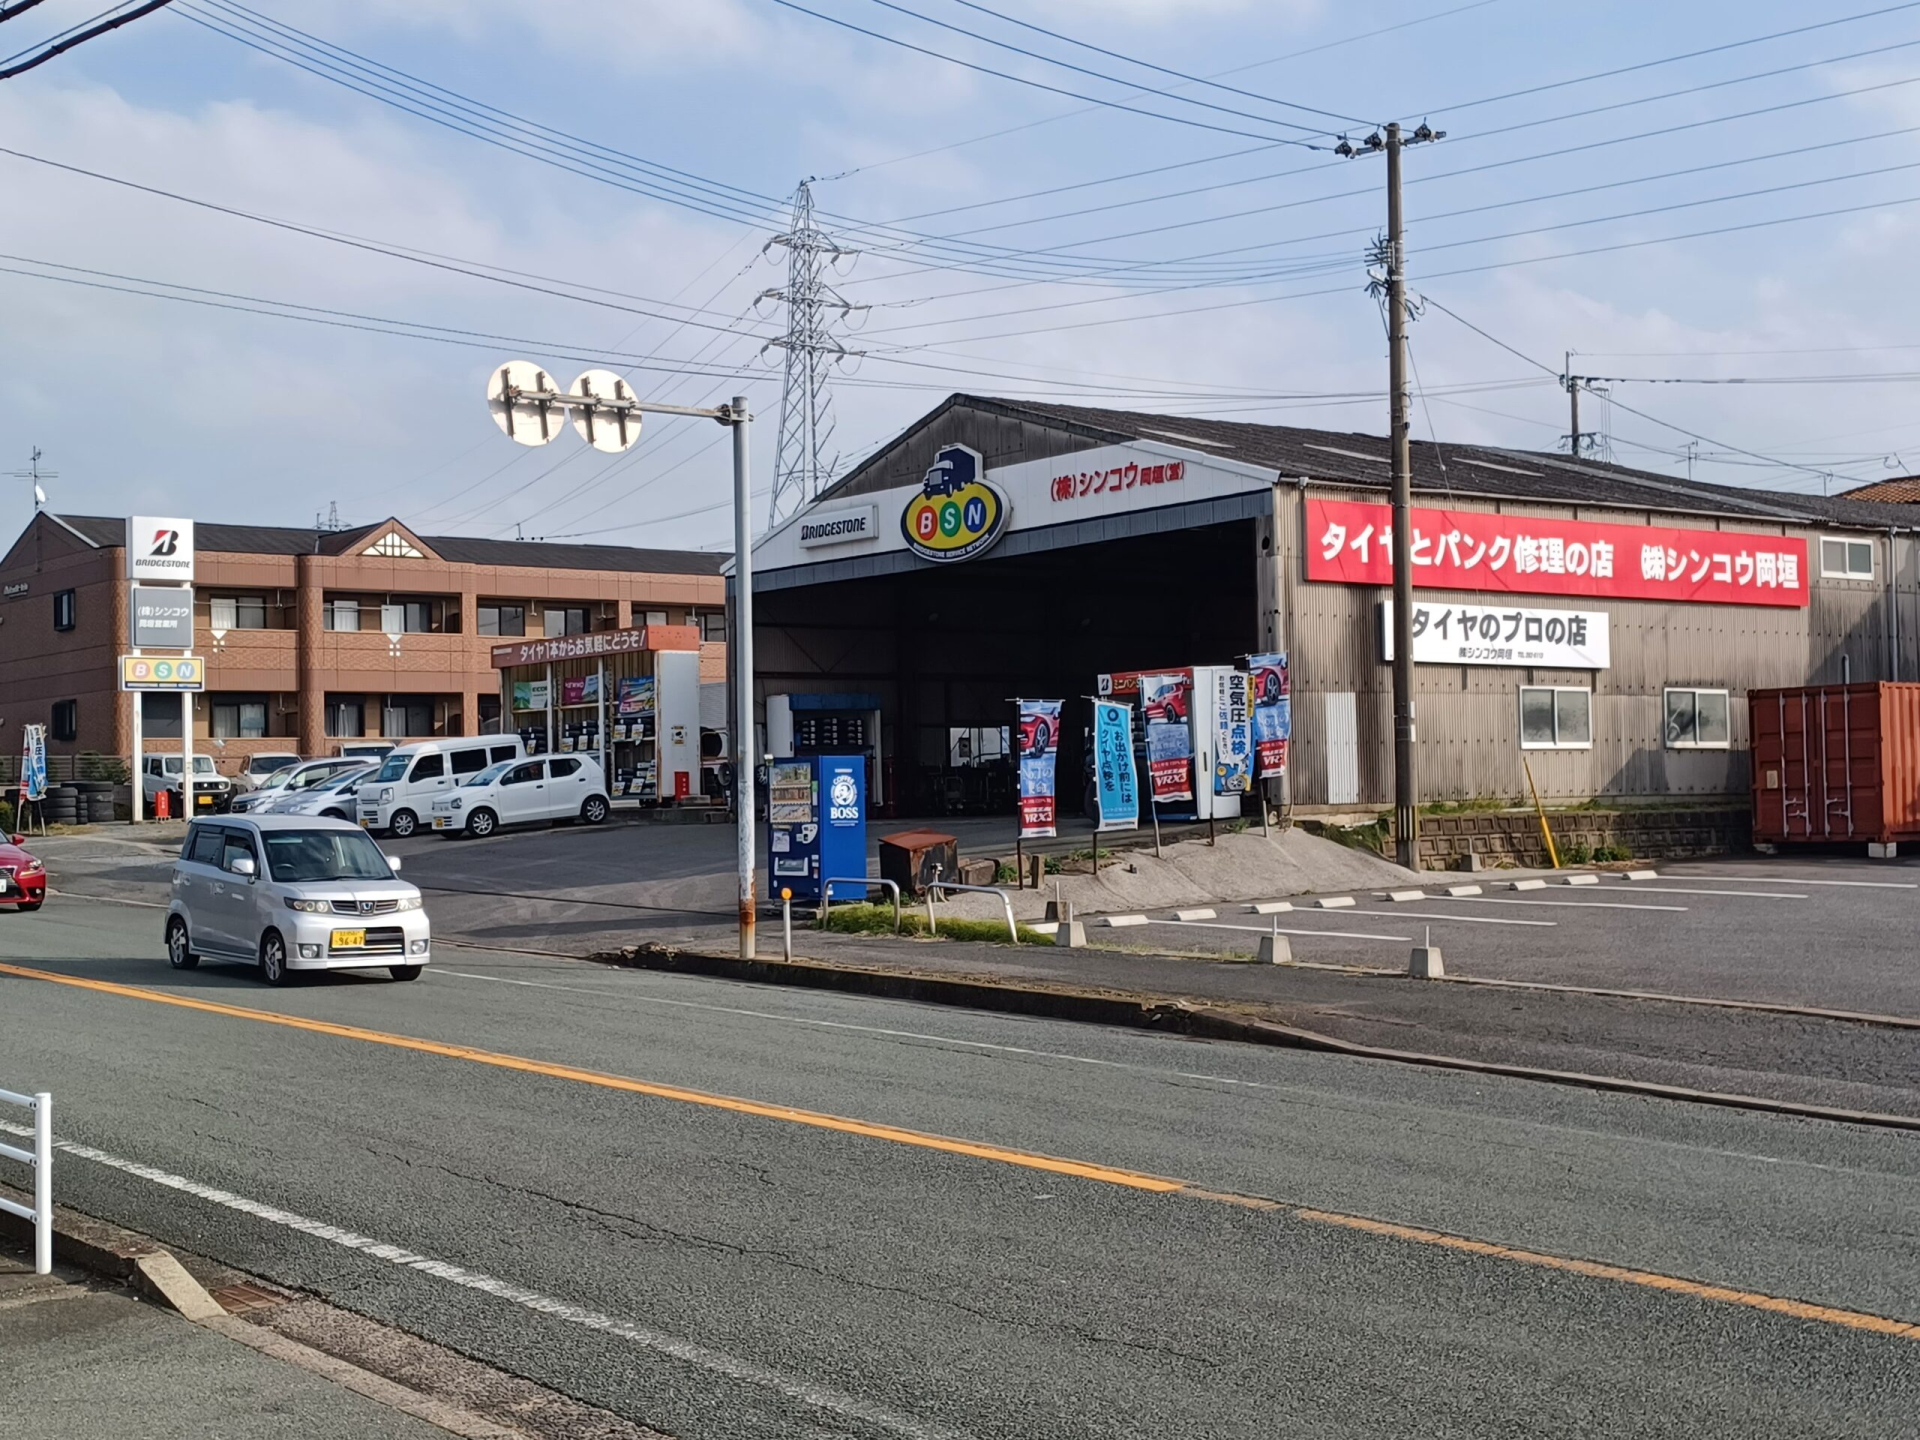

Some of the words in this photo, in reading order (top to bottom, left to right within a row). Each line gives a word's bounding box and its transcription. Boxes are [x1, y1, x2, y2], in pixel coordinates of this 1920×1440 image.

[801, 517, 866, 540] BRIDGESTONE
[921, 503, 981, 534] BSN
[135, 559, 190, 568] BRIDGESTONE
[1412, 608, 1587, 646] タイヤのプロの店
[135, 664, 192, 677] BSN
[1229, 674, 1247, 756] 空気圧点検
[1114, 731, 1133, 803] お出かけ前には
[830, 807, 858, 819] BOSS
